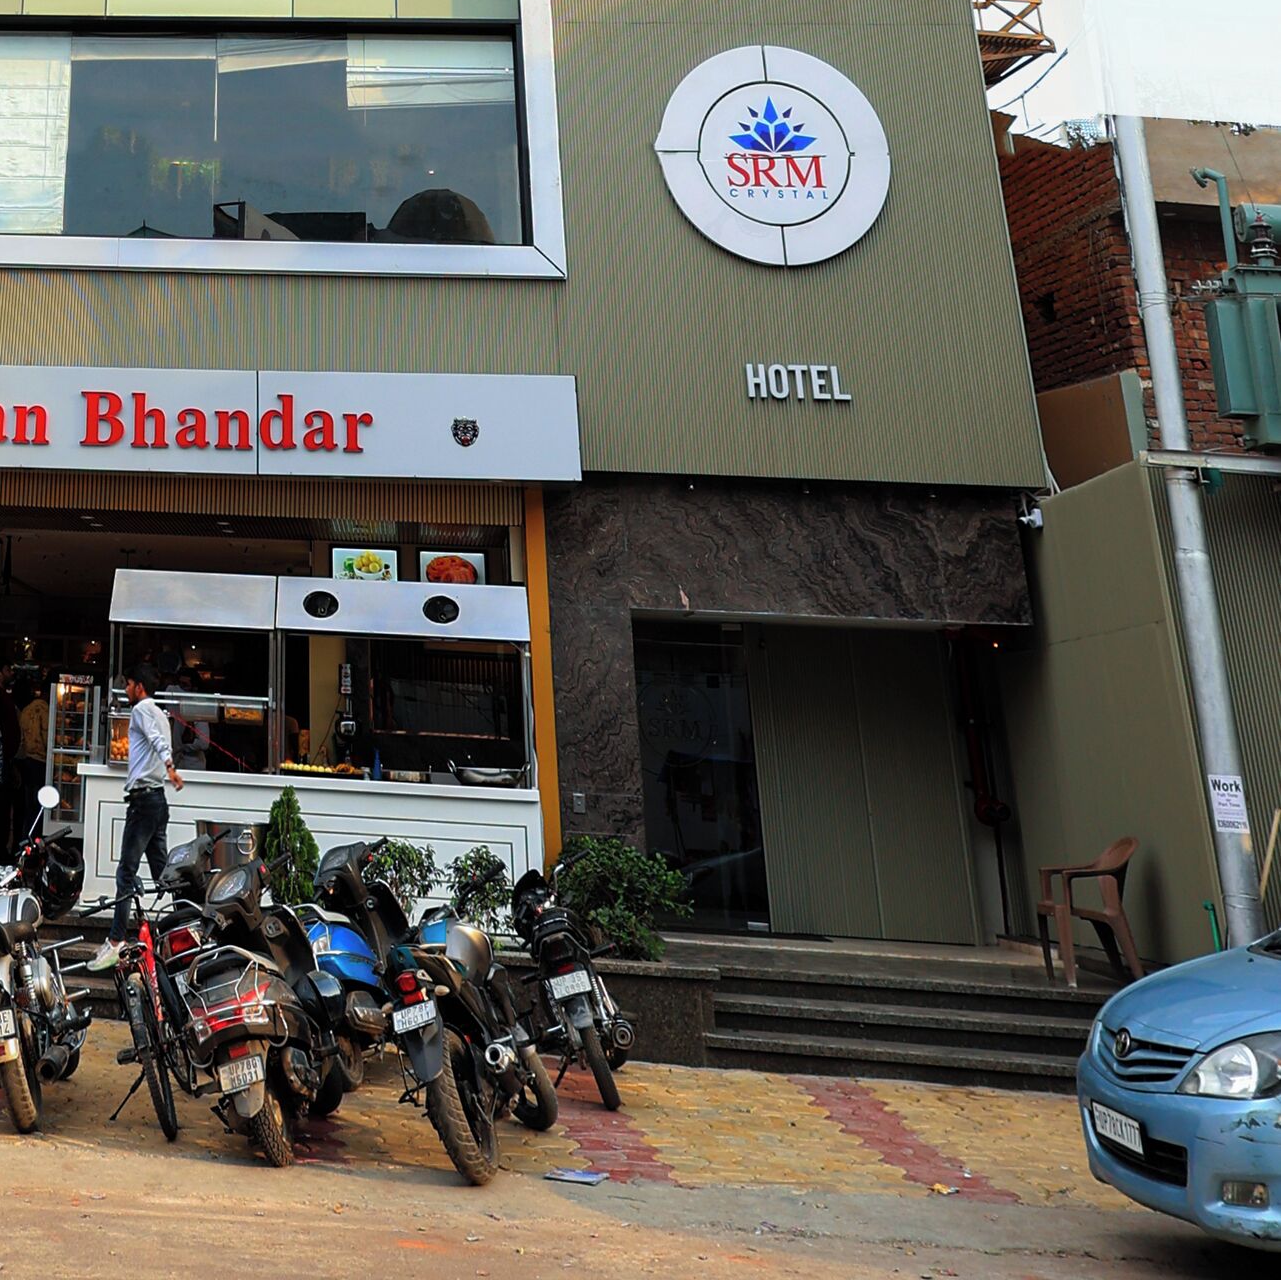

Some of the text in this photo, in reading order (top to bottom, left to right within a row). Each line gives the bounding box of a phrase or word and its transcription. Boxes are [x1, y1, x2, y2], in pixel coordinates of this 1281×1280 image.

[726, 152, 827, 189] SRM
[729, 188, 829, 200] CRYSTAL
[746, 363, 852, 401] HOTEL
[80, 389, 373, 455] Bhandar
[1210, 779, 1241, 792] Work
